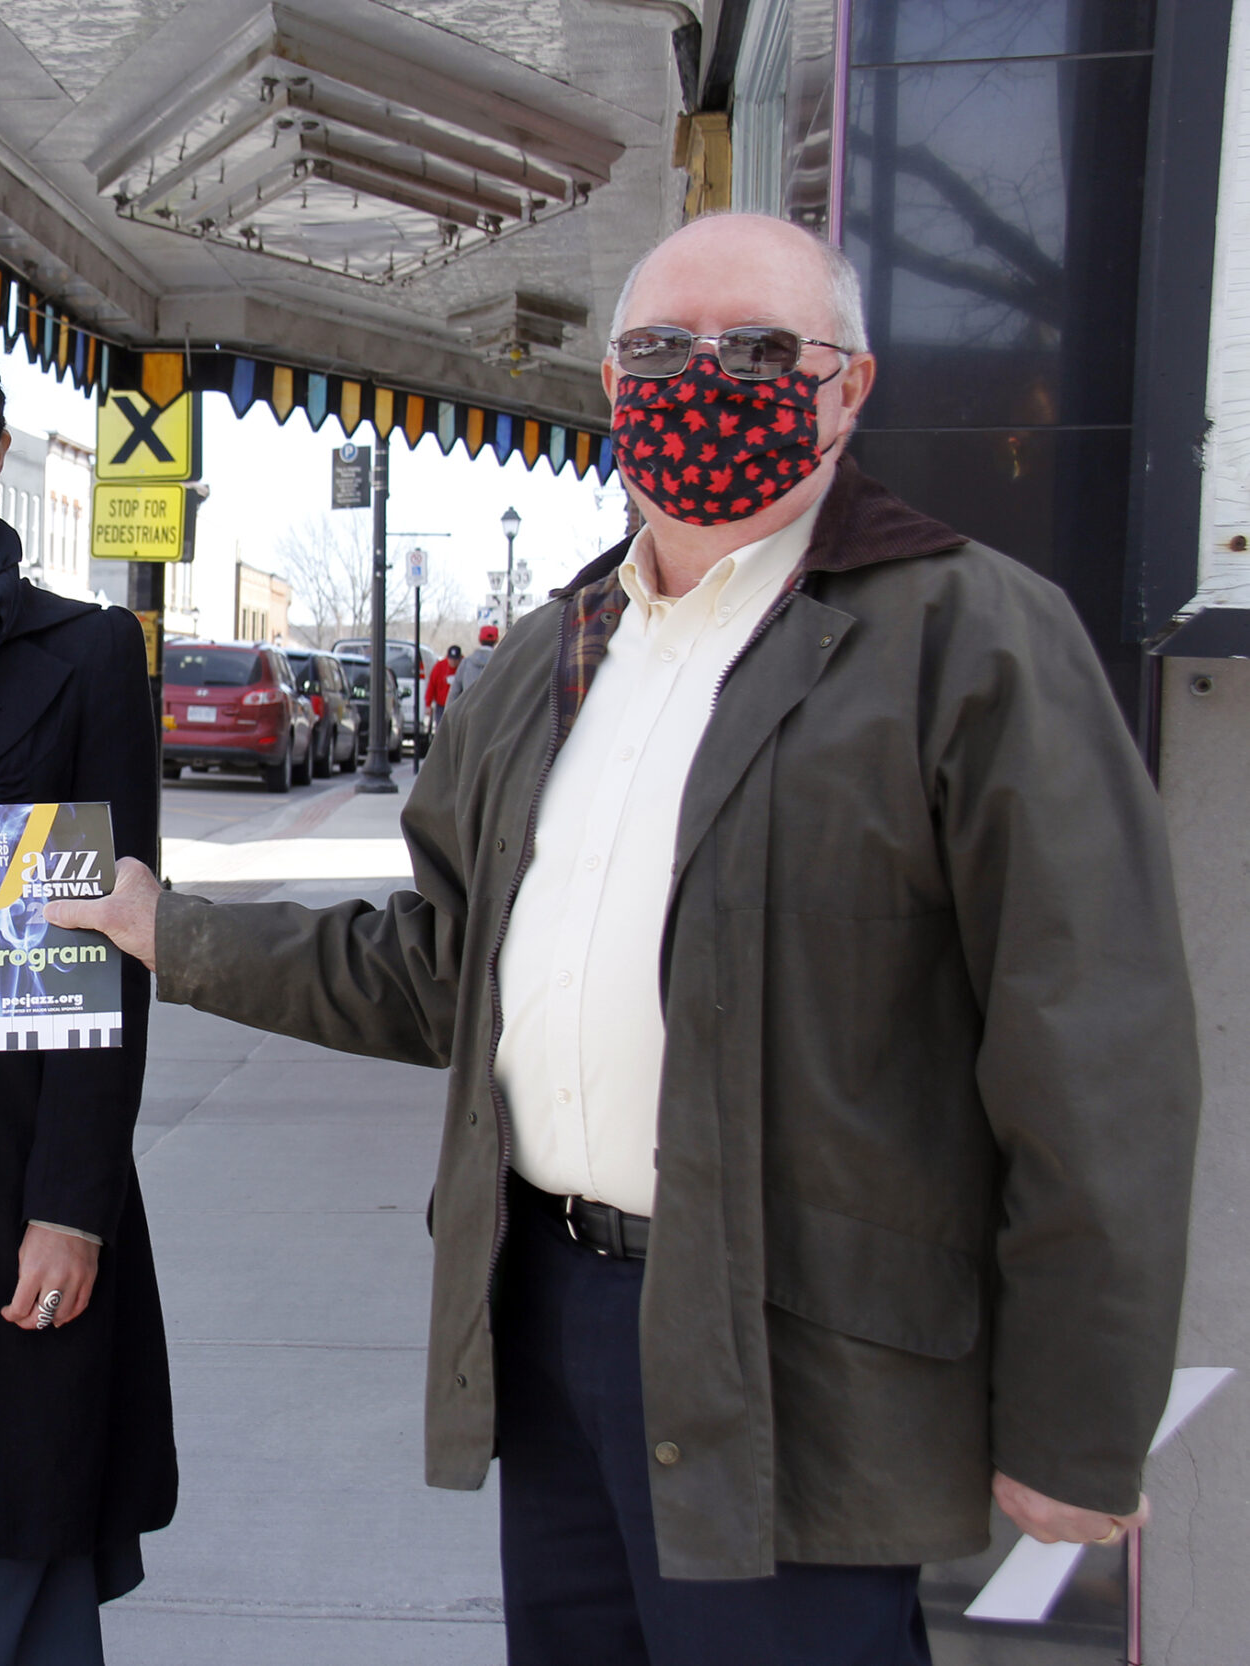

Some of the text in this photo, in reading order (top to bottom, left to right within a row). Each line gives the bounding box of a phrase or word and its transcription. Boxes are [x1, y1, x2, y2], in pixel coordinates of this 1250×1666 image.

[109, 500, 167, 518] STOP FOR
[95, 525, 177, 545] PEDESTRIANS
[22, 882, 103, 898] FESTIVAL
[25, 902, 47, 925] 2
[2, 993, 83, 1008] pecjazz.org
